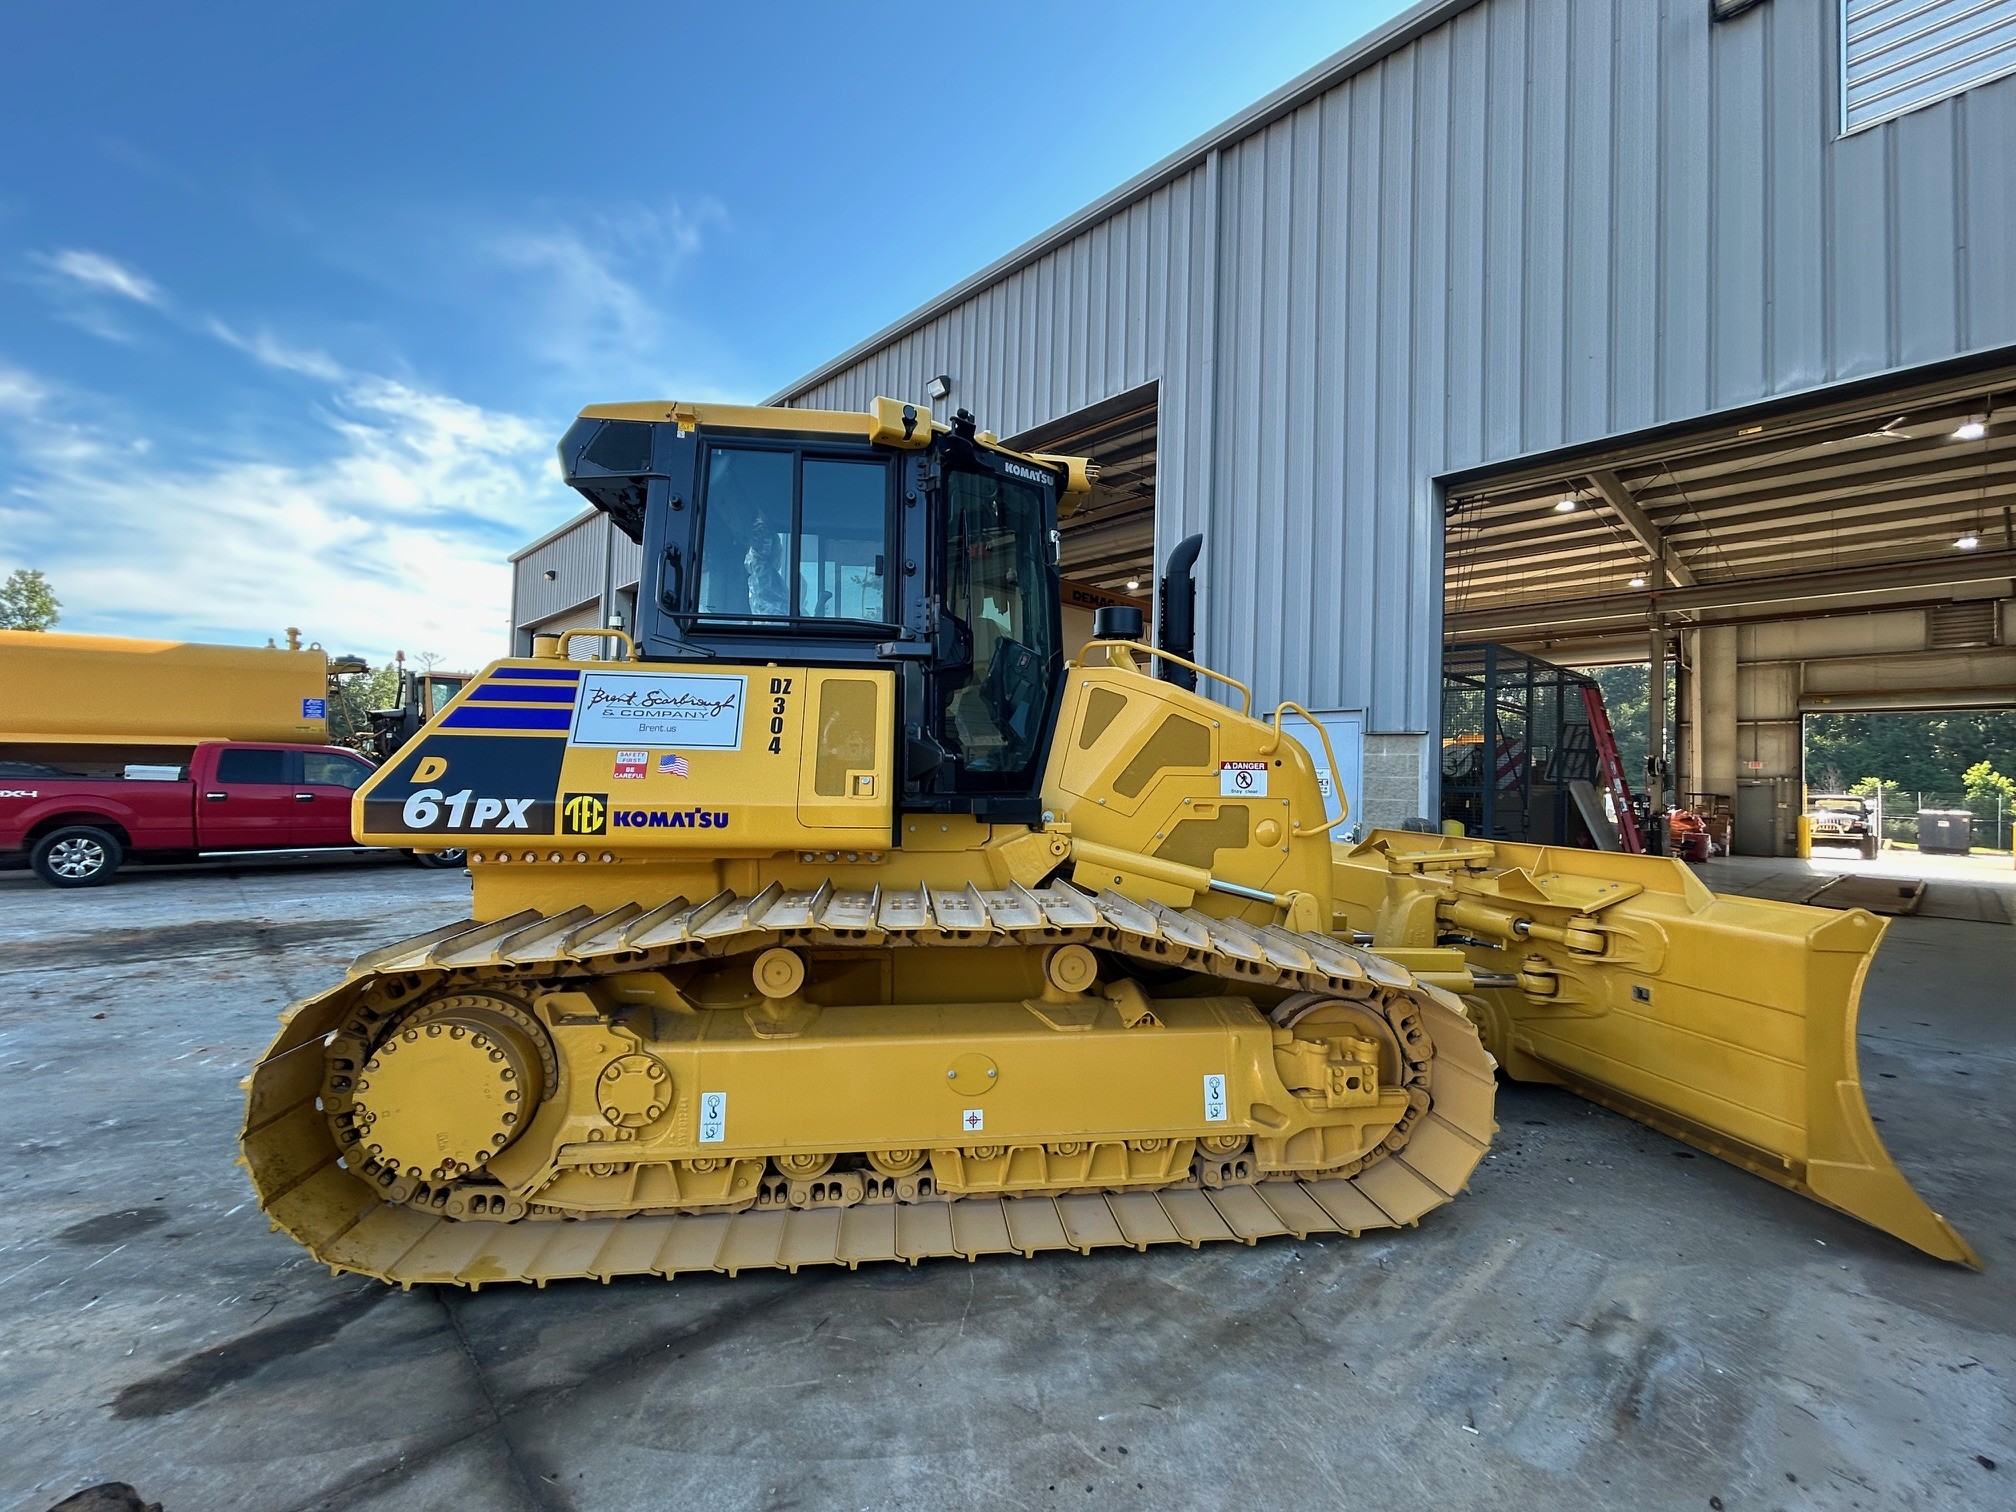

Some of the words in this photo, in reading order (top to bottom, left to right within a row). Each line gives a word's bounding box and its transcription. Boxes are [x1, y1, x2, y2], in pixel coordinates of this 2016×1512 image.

[1004, 462, 1054, 486] KOMATSU
[769, 677, 793, 695] DZ
[587, 687, 638, 710] Brent
[642, 689, 735, 717] Scarbrough
[620, 709, 709, 719] COMPANY
[638, 723, 677, 733] Brent.us
[410, 756, 448, 783] D
[1232, 762, 1265, 770] DANGER
[0, 790, 38, 798] X4
[402, 788, 535, 829] 61PX
[613, 807, 729, 828] KOMATSU
